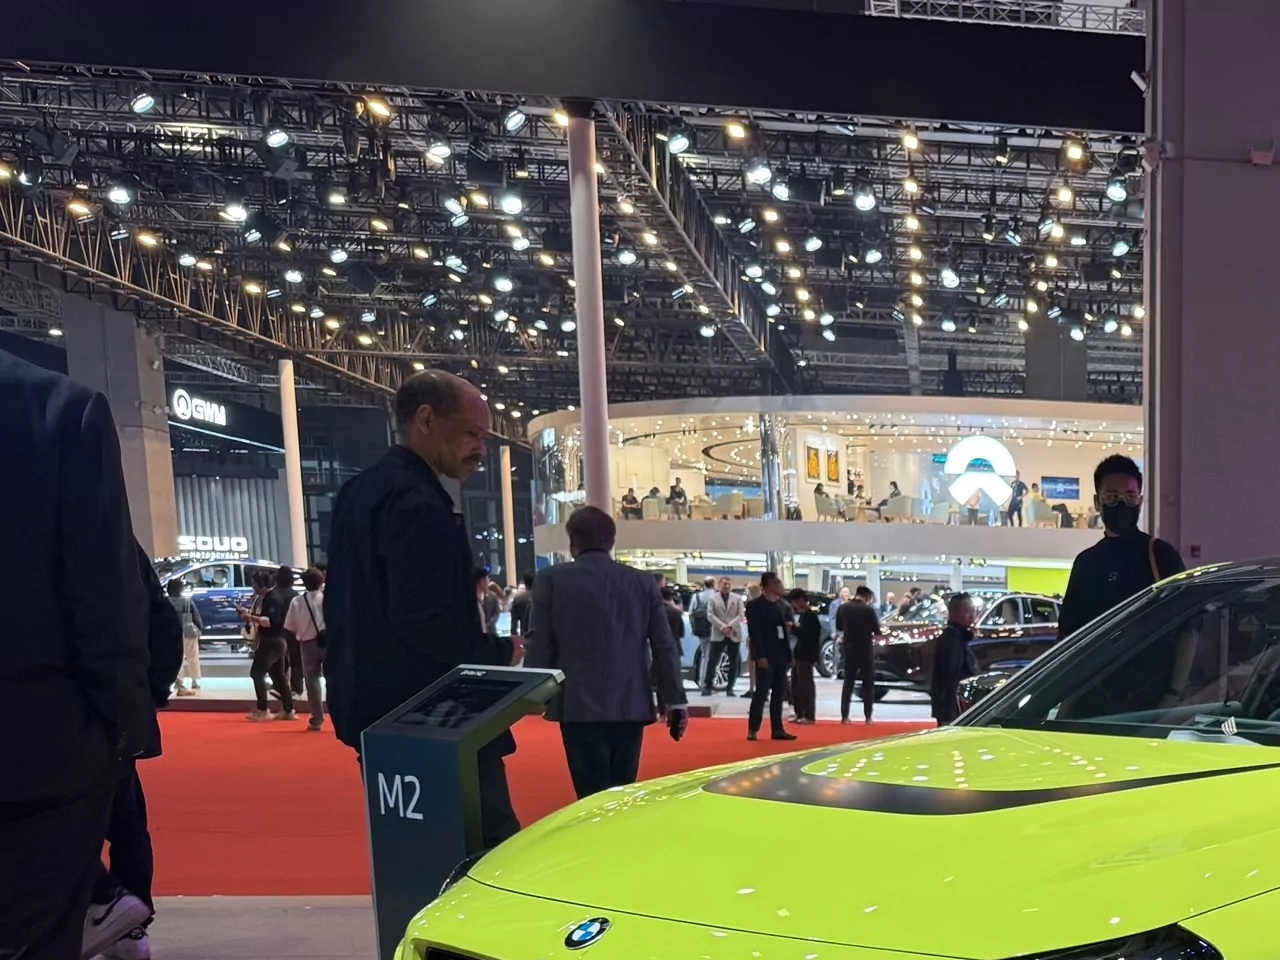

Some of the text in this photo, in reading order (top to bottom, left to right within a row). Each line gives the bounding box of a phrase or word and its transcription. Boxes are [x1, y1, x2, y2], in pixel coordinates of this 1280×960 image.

[192, 397, 227, 426] GWM
[179, 535, 248, 552] SOUO
[378, 772, 424, 820] M2
